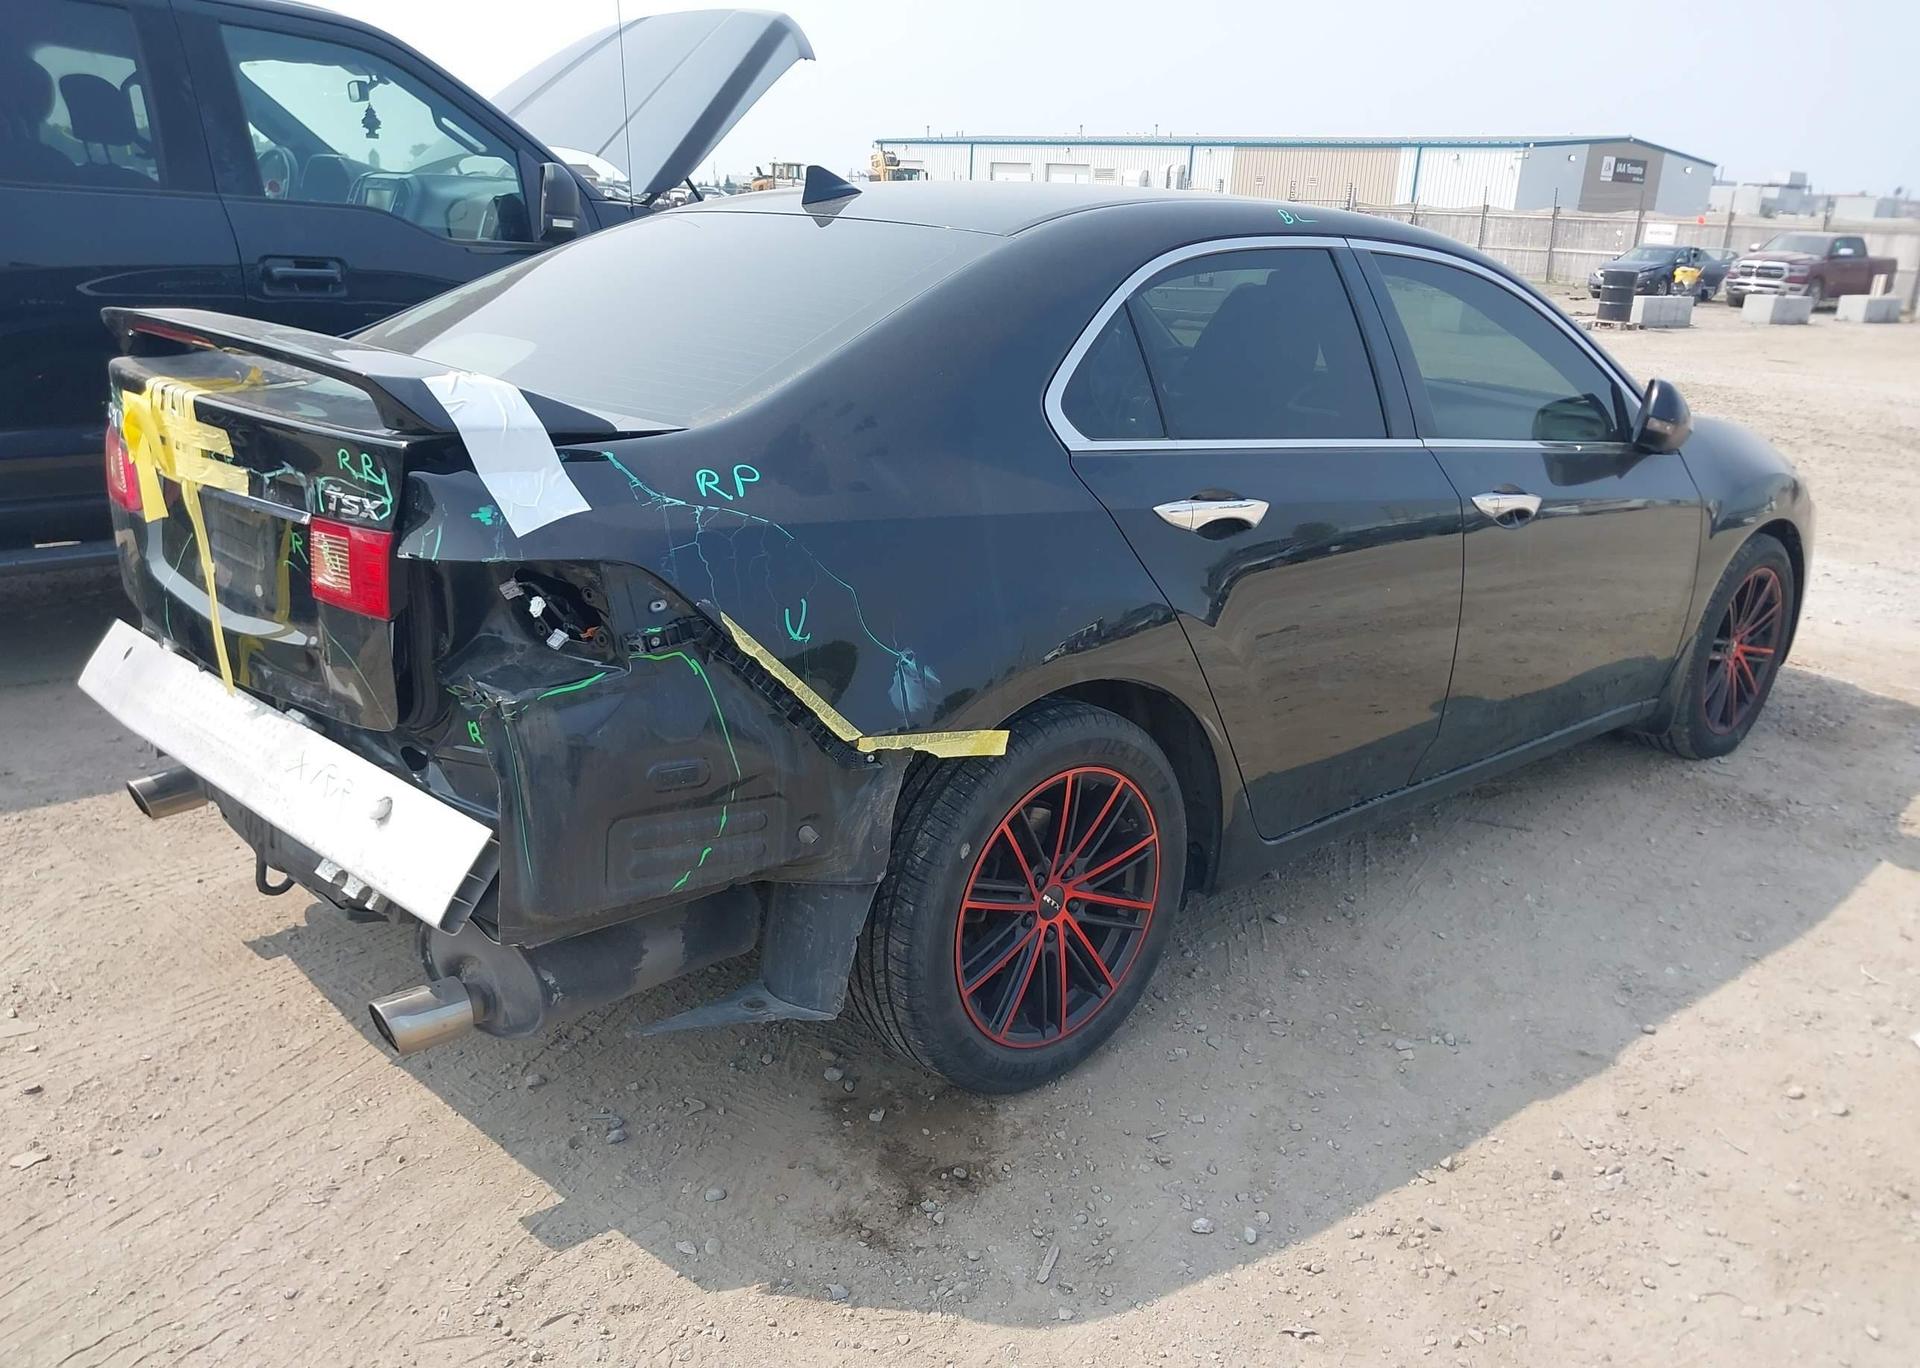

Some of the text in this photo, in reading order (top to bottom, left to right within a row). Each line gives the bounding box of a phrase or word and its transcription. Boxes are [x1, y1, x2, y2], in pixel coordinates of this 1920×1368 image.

[695, 464, 760, 500] RP
[324, 489, 385, 522] TSX
[467, 720, 486, 745] R
[1042, 893, 1061, 911] RTX
